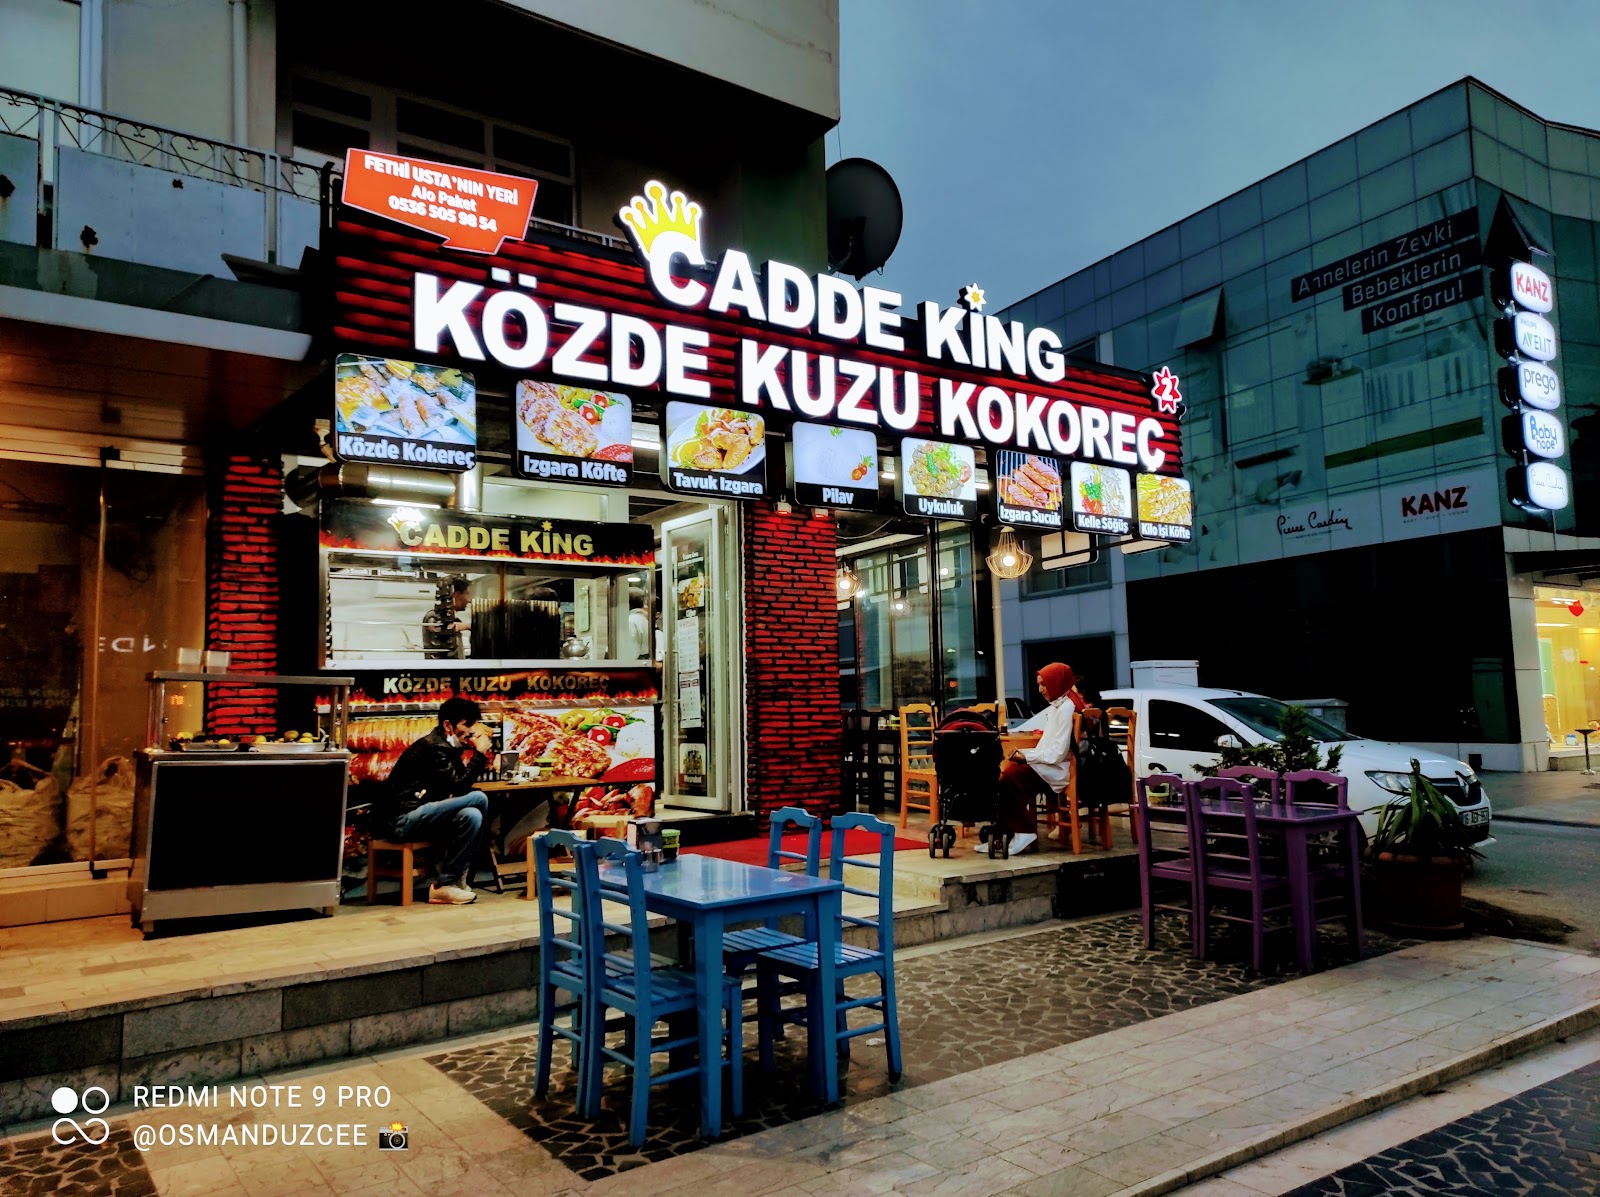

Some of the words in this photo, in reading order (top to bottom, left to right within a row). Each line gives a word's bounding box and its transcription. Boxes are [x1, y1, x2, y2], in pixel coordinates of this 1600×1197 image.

[364, 154, 410, 179] FETHİ
[412, 166, 484, 198] USTA'NIN
[486, 184, 518, 205] YERİ
[411, 185, 436, 202] Alo
[438, 190, 477, 212] Paket
[388, 195, 427, 216] 0536
[428, 205, 457, 223] 505
[458, 212, 478, 228] 98
[479, 217, 497, 232] 54
[1299, 249, 1388, 296] Annelerin
[1396, 220, 1452, 258] Zevki
[1352, 253, 1461, 304] Bebeklerin
[1515, 271, 1549, 302] KANZ
[648, 230, 905, 351] CADDE
[924, 283, 1066, 383] KİNG
[1372, 279, 1463, 327] Konforu!
[414, 266, 711, 400] KÖZDE
[741, 338, 919, 432] KUZU
[939, 378, 1167, 473] KOKOREÇ
[1523, 368, 1556, 395] prego
[1161, 377, 1174, 401] 2
[1529, 415, 1558, 444] Baby
[338, 435, 400, 460] Közde
[402, 440, 475, 469] Kokereç
[523, 455, 579, 479] Izgara
[582, 460, 627, 483] Köfte
[673, 471, 718, 490] Tavuk
[720, 478, 763, 495] Izgara
[822, 487, 854, 505] Pilav
[918, 499, 964, 516] Uykuluk
[1402, 486, 1468, 518] KANZ
[999, 504, 1030, 522] Izgara
[1031, 508, 1062, 526] Sucuk
[1078, 514, 1101, 528] Kelle
[1102, 516, 1129, 534] Söğüş
[1308, 508, 1353, 530] Cardin
[399, 520, 510, 551] CADDE
[520, 520, 594, 556] KİNG
[1141, 522, 1157, 535] Kilo
[1168, 526, 1191, 539] Köfte
[383, 673, 451, 694] KÖZDE
[459, 676, 512, 692] KUZU
[527, 675, 610, 693] KOKOREÇ
